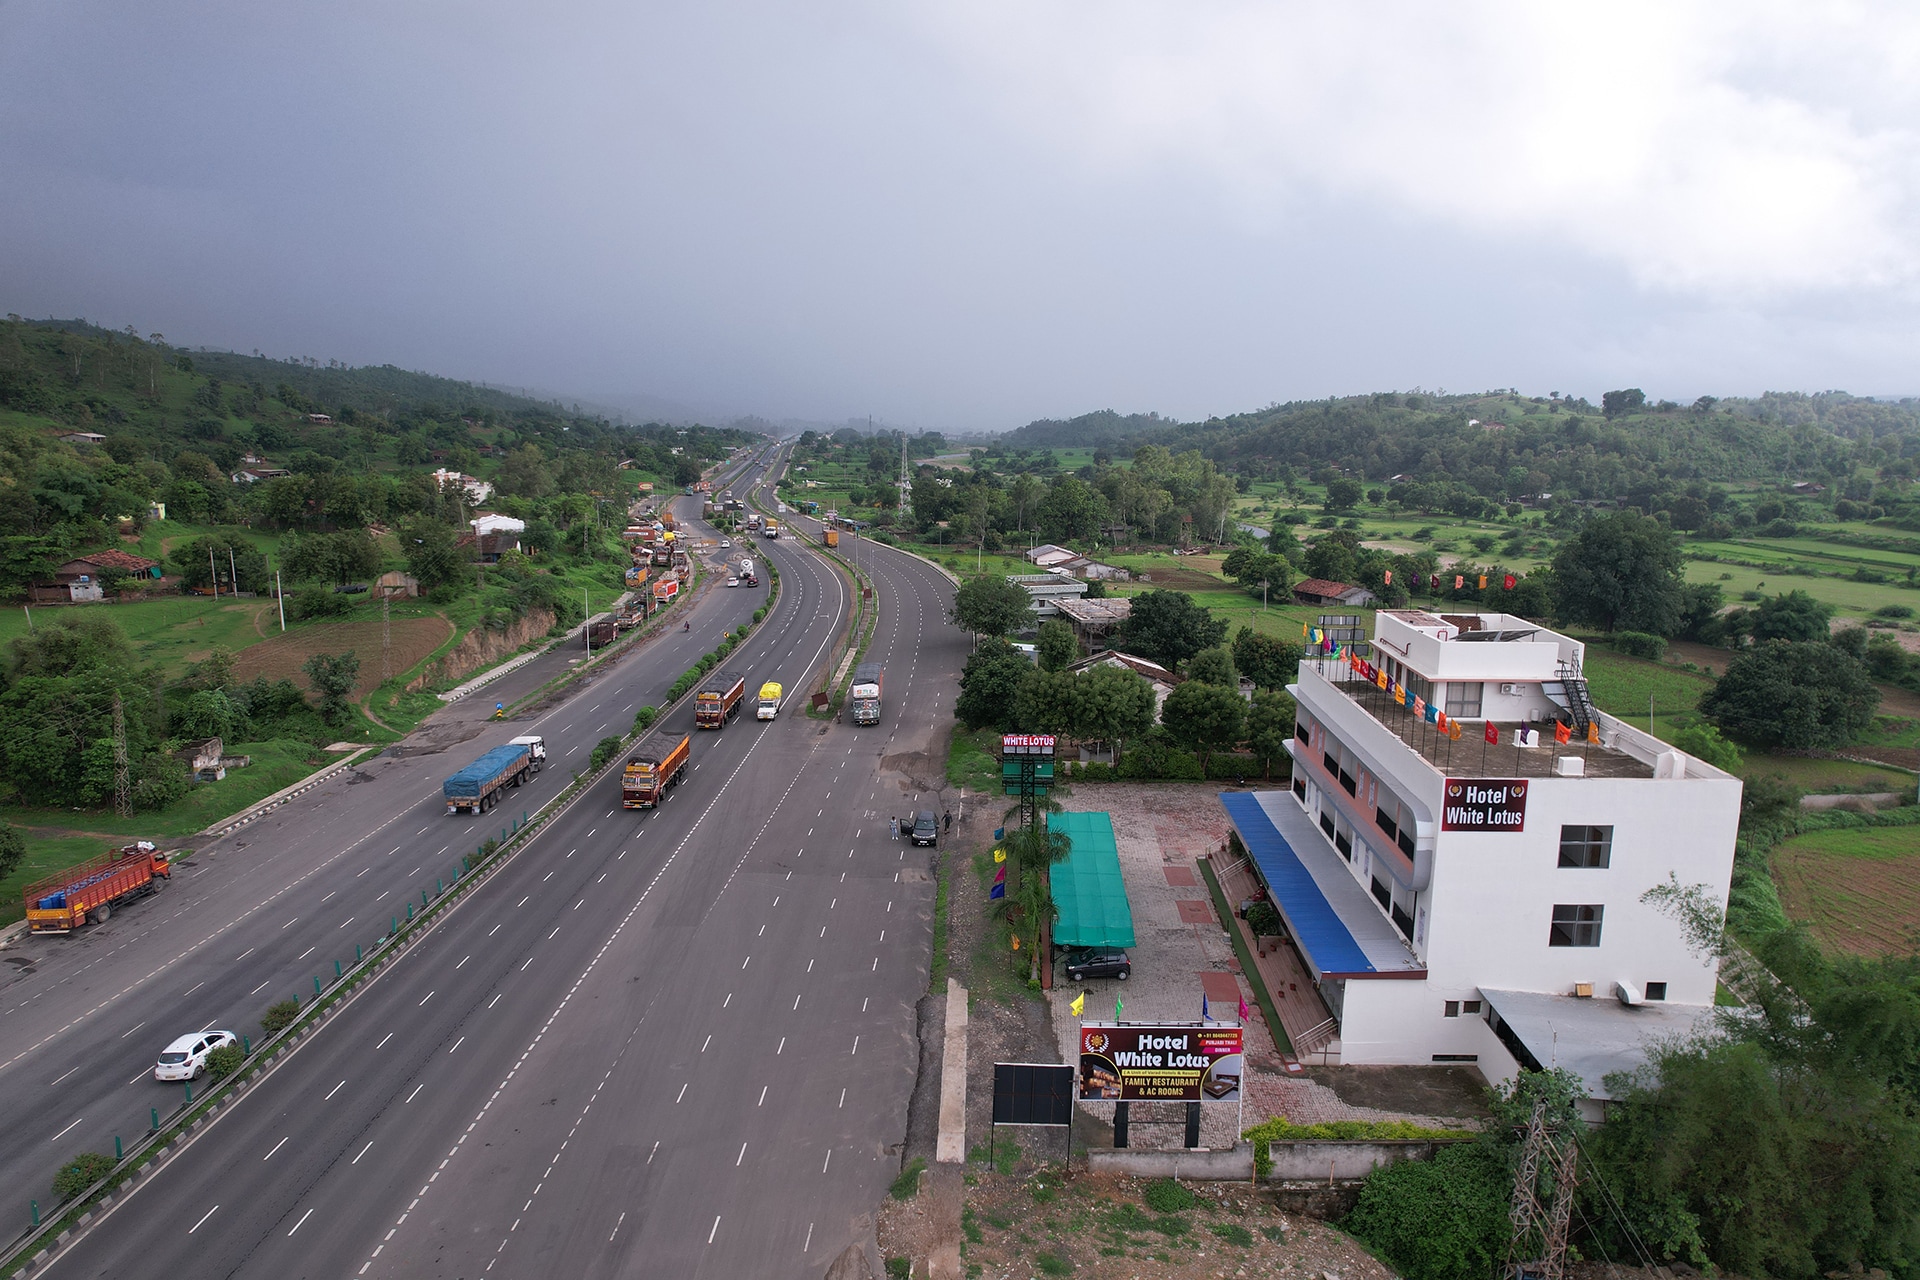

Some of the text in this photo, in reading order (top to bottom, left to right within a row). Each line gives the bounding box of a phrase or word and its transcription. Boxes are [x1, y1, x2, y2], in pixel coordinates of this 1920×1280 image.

[1004, 738, 1054, 746] WHITE LOTUS
[1466, 786, 1507, 804] Hotel
[1446, 806, 1522, 824] White Lotus
[1138, 1034, 1188, 1050] Hotel
[1114, 1052, 1210, 1068] White Lotus
[1124, 1078, 1199, 1086] FAMILY RESTAURANT
[1139, 1088, 1184, 1096] & AC ROOMS
